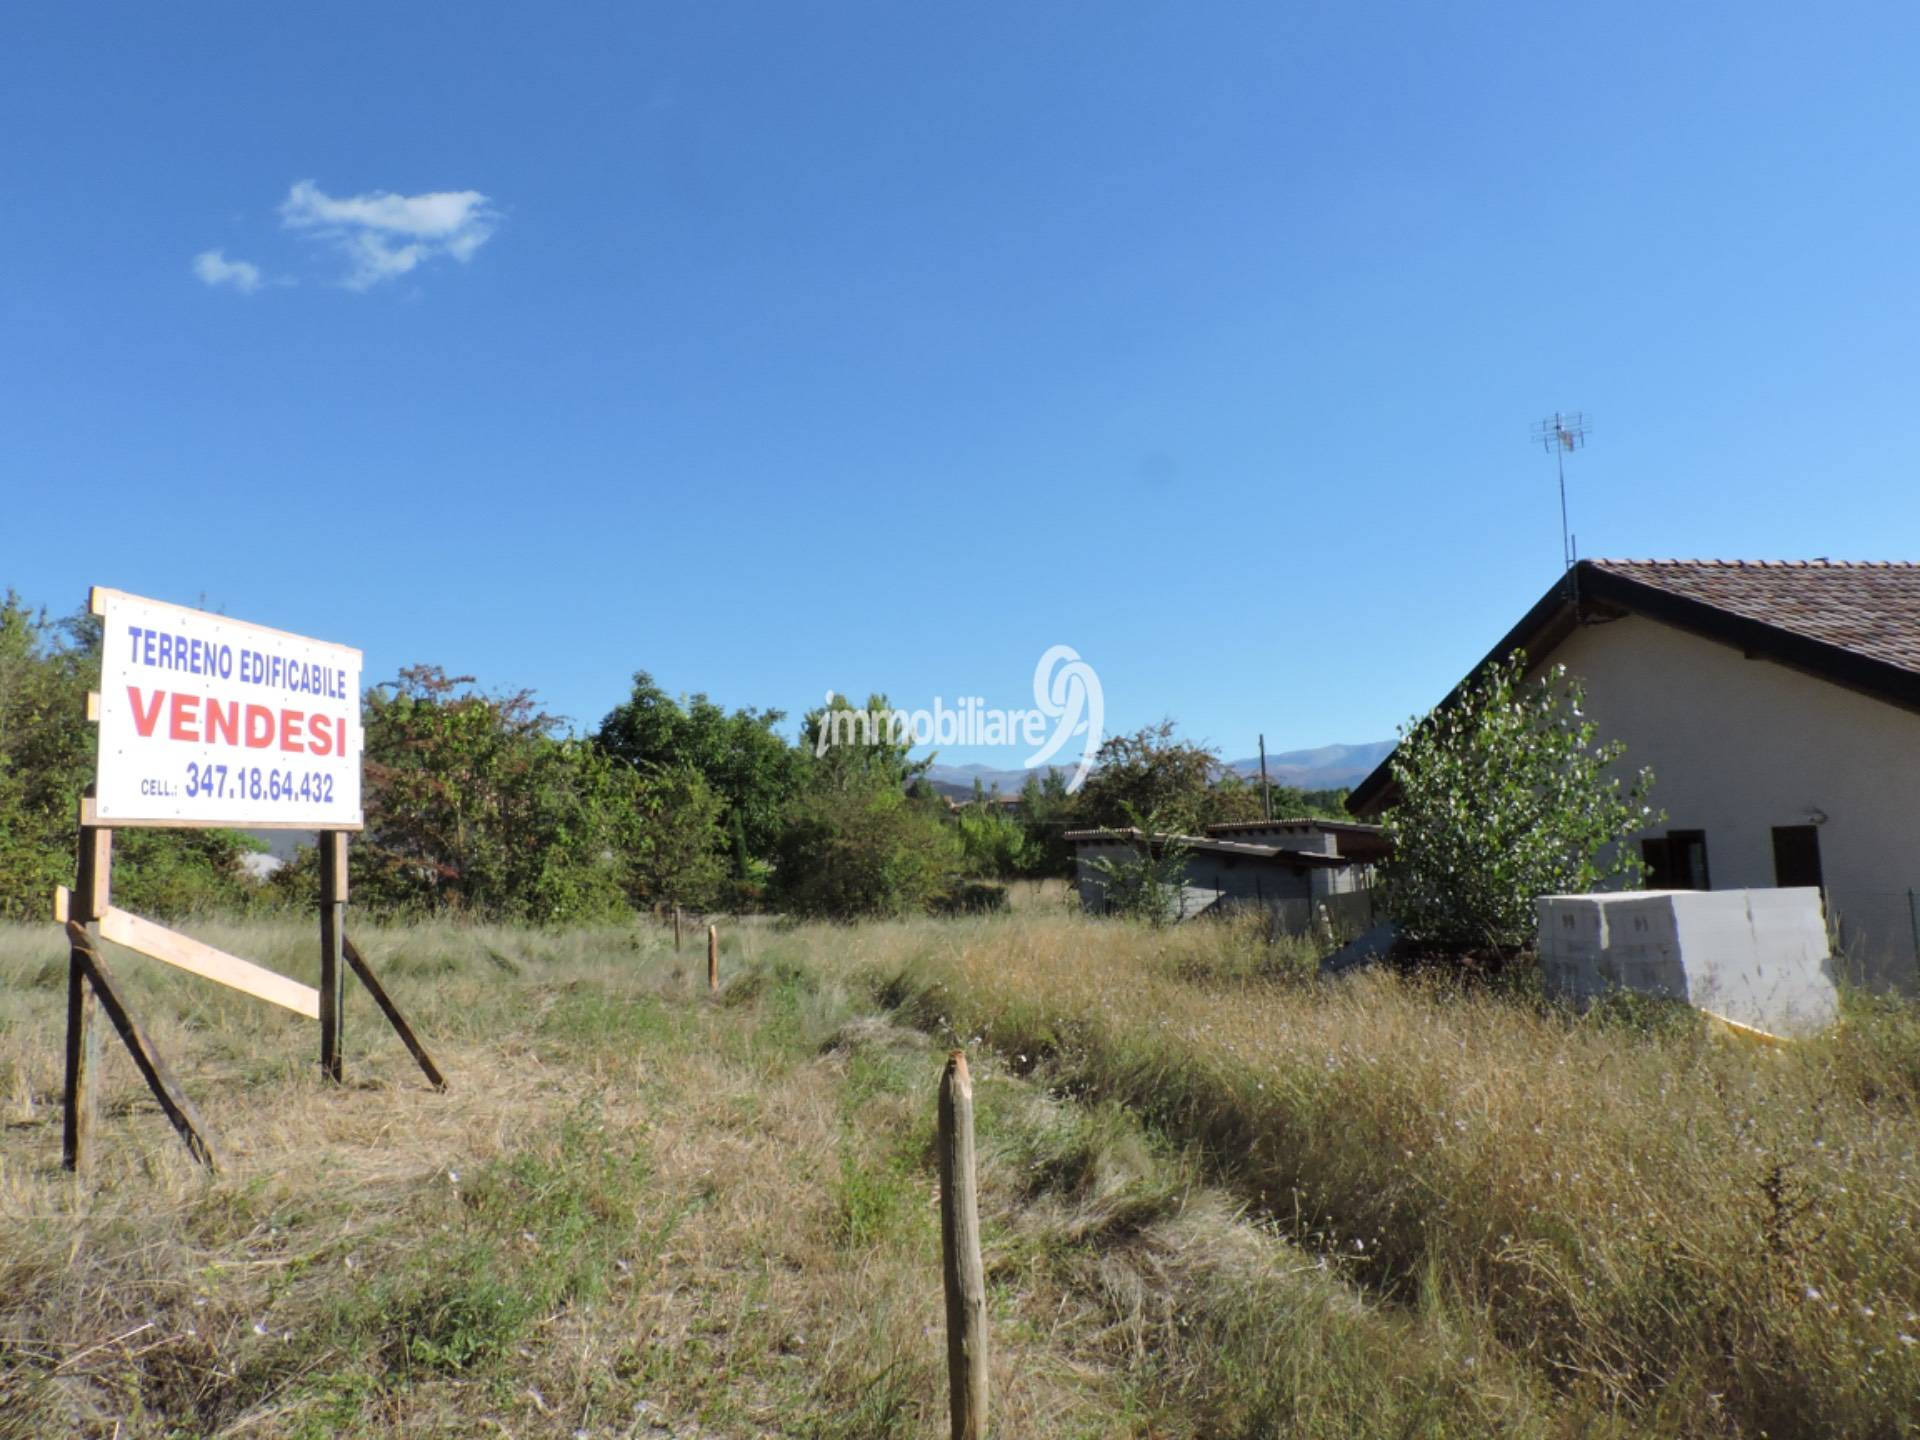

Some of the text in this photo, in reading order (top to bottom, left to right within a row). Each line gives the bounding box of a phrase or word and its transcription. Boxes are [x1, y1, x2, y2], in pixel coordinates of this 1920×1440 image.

[128, 626, 346, 699] TERRENO EDIFICABILE
[127, 686, 346, 757] VENDESI
[186, 762, 334, 802] 347.18.64.432
